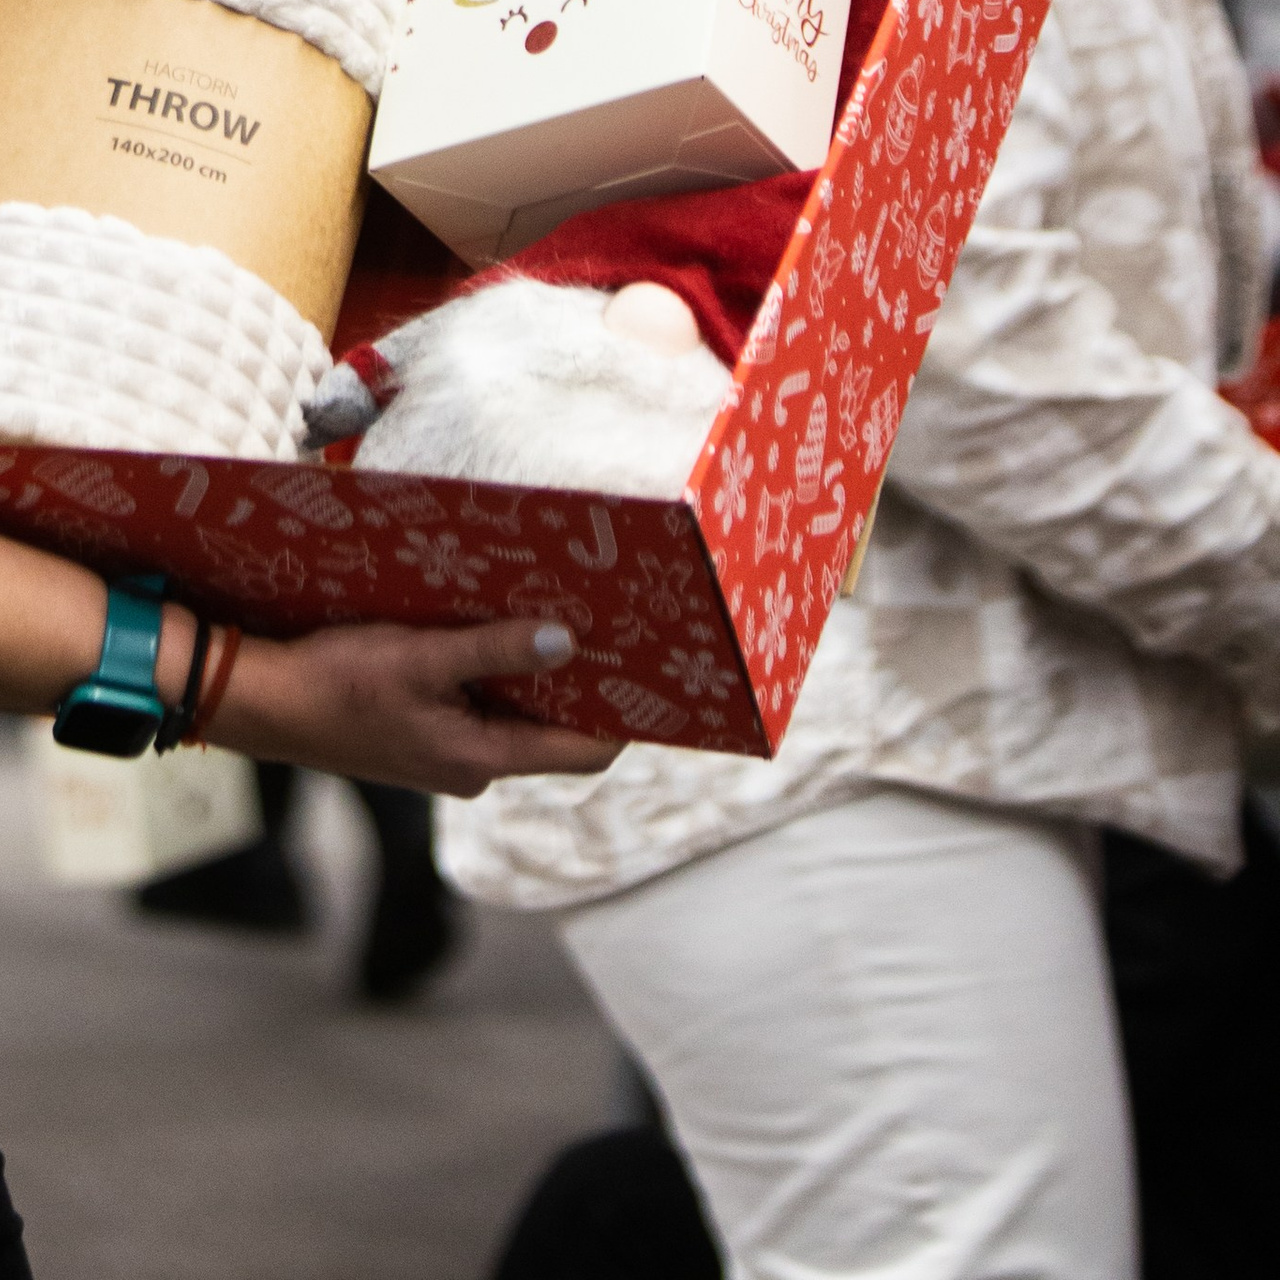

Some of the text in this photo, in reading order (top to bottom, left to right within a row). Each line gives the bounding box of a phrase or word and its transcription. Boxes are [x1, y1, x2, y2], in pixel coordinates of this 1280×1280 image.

[144, 60, 238, 100] HAGTORN
[107, 77, 261, 147] THROW
[111, 137, 228, 184] 140x200 cm
